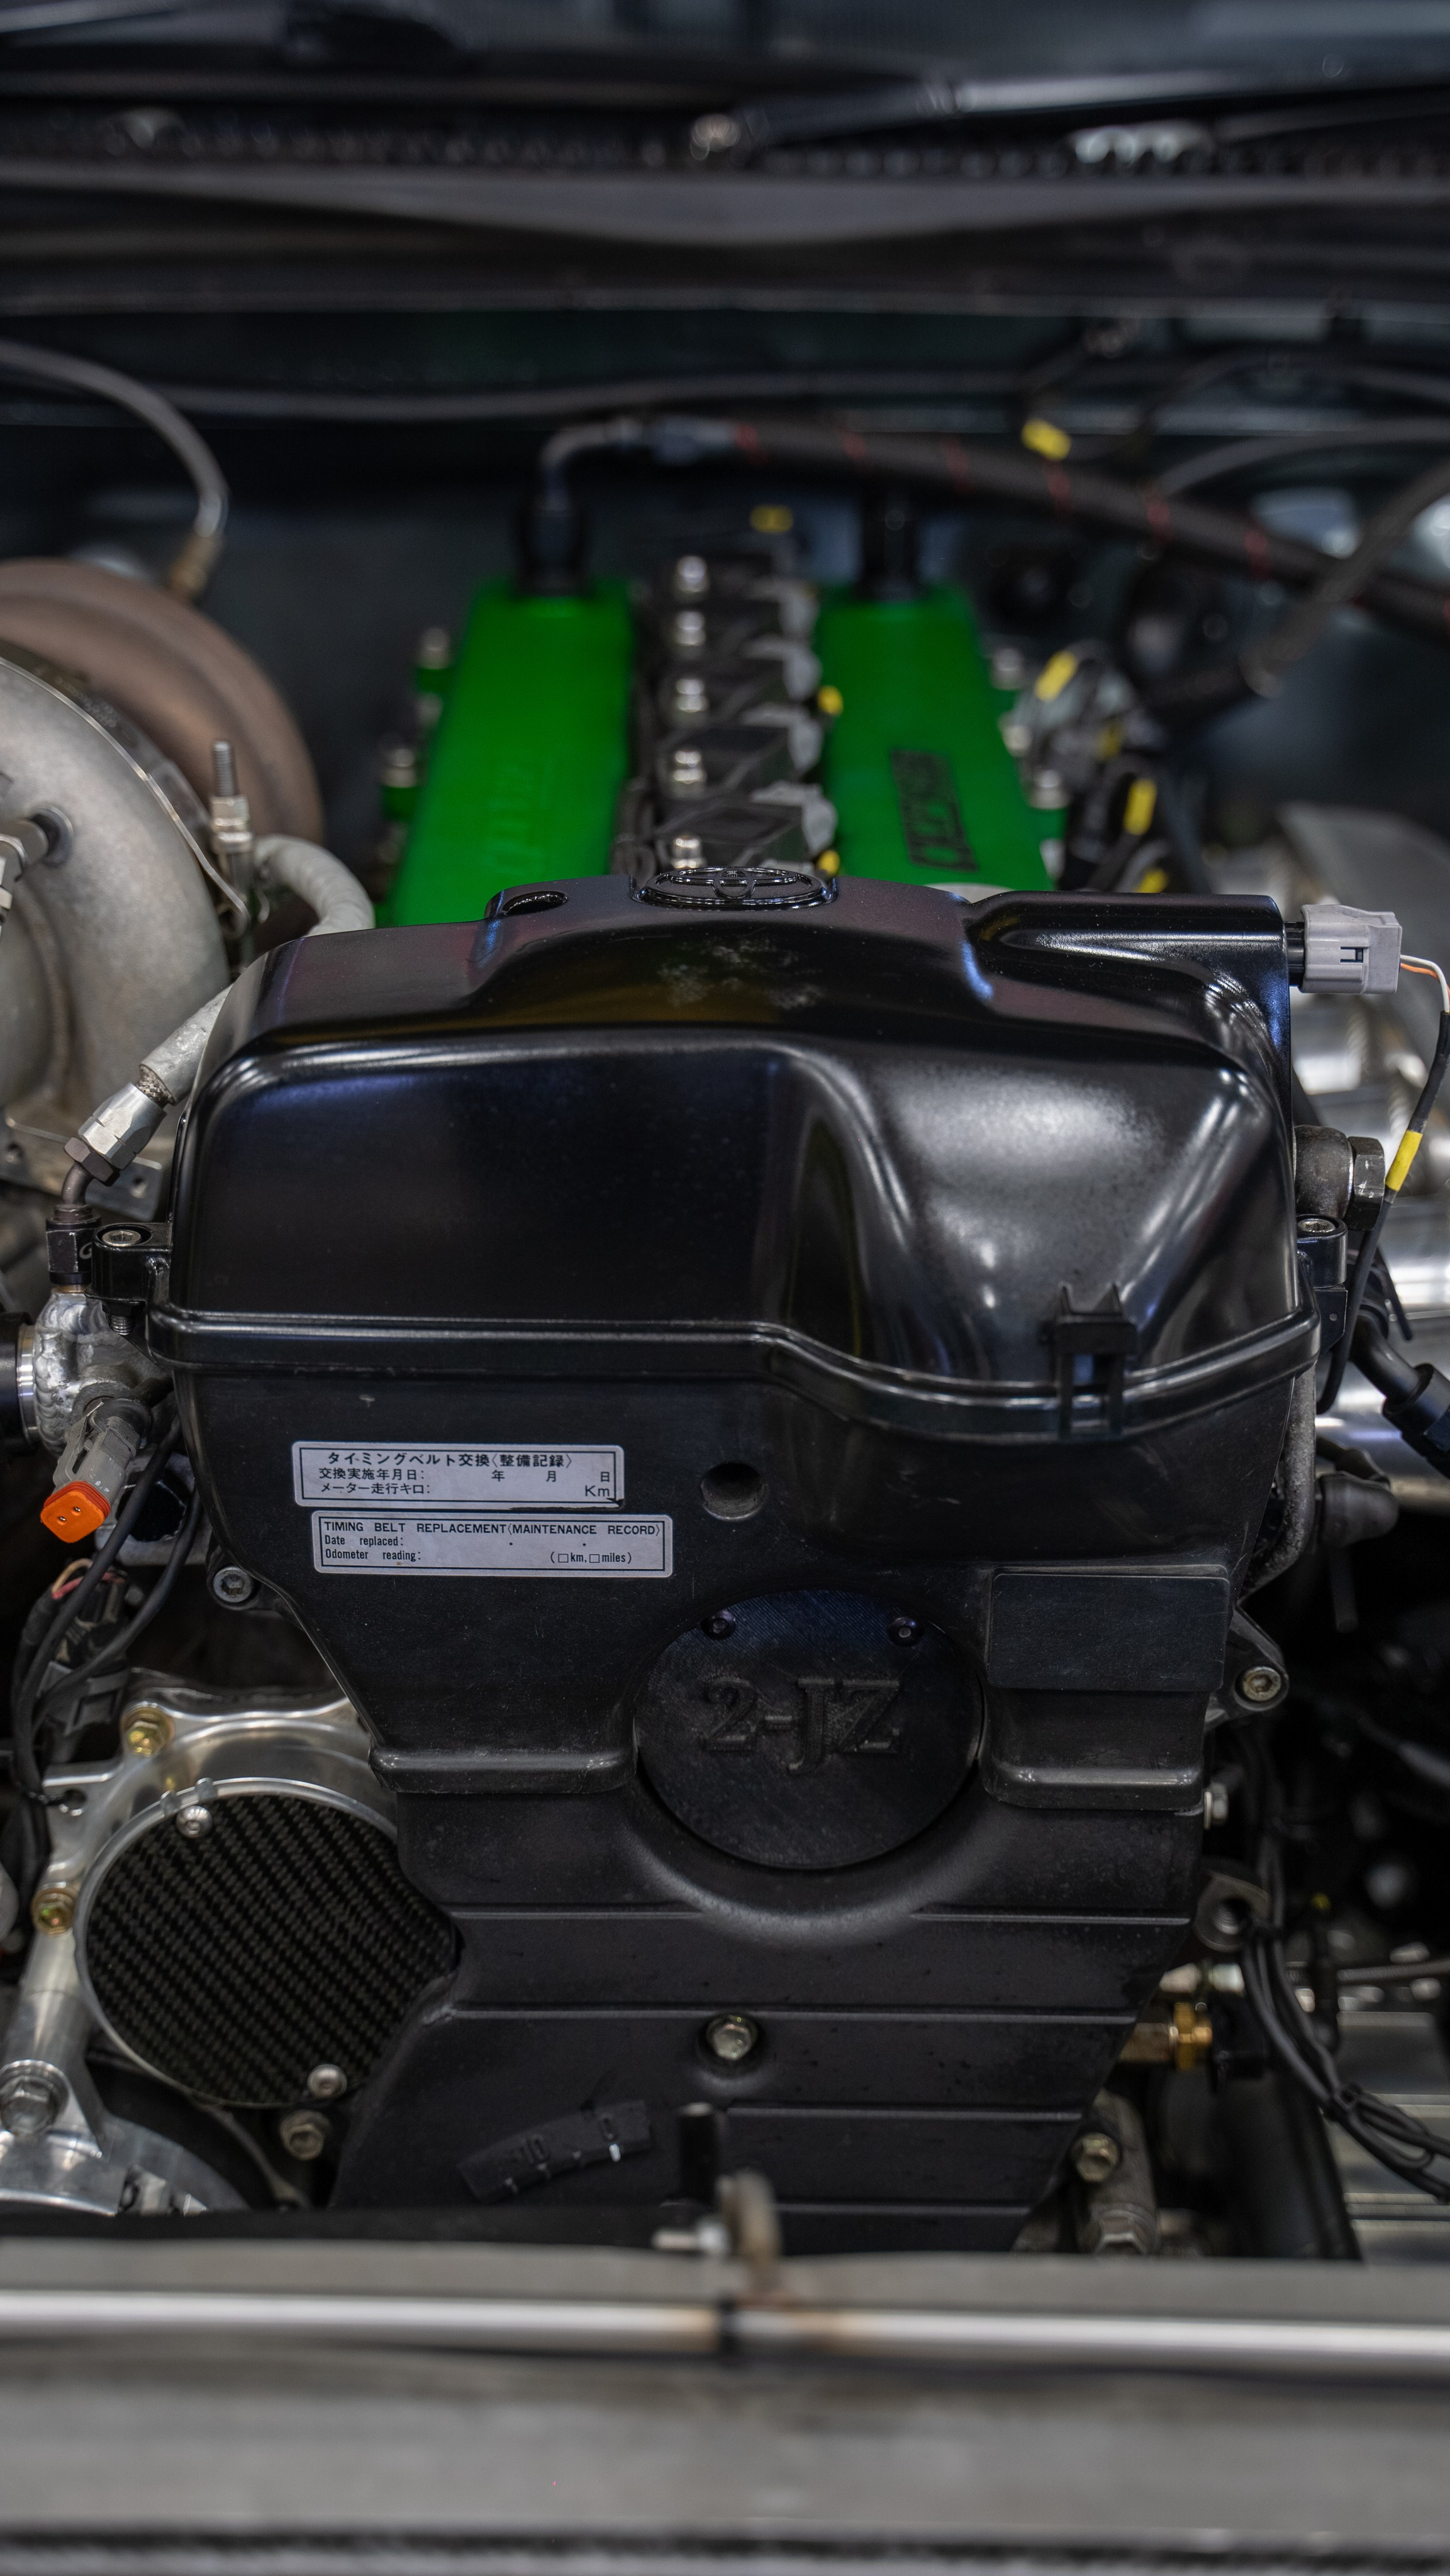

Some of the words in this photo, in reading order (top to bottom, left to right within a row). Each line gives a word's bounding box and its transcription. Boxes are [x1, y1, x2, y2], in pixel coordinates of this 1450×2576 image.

[491, 1469, 505, 1482] 年
[545, 1470, 557, 1483] 月
[600, 1472, 610, 1483] 日
[584, 1485, 610, 1497] Km
[324, 1521, 364, 1532] TIMING
[374, 1522, 406, 1533] BELT
[325, 1535, 345, 1545] Date
[359, 1536, 404, 1548] replaced:
[325, 1548, 369, 1560] Odometer
[382, 1550, 421, 1562] reading:
